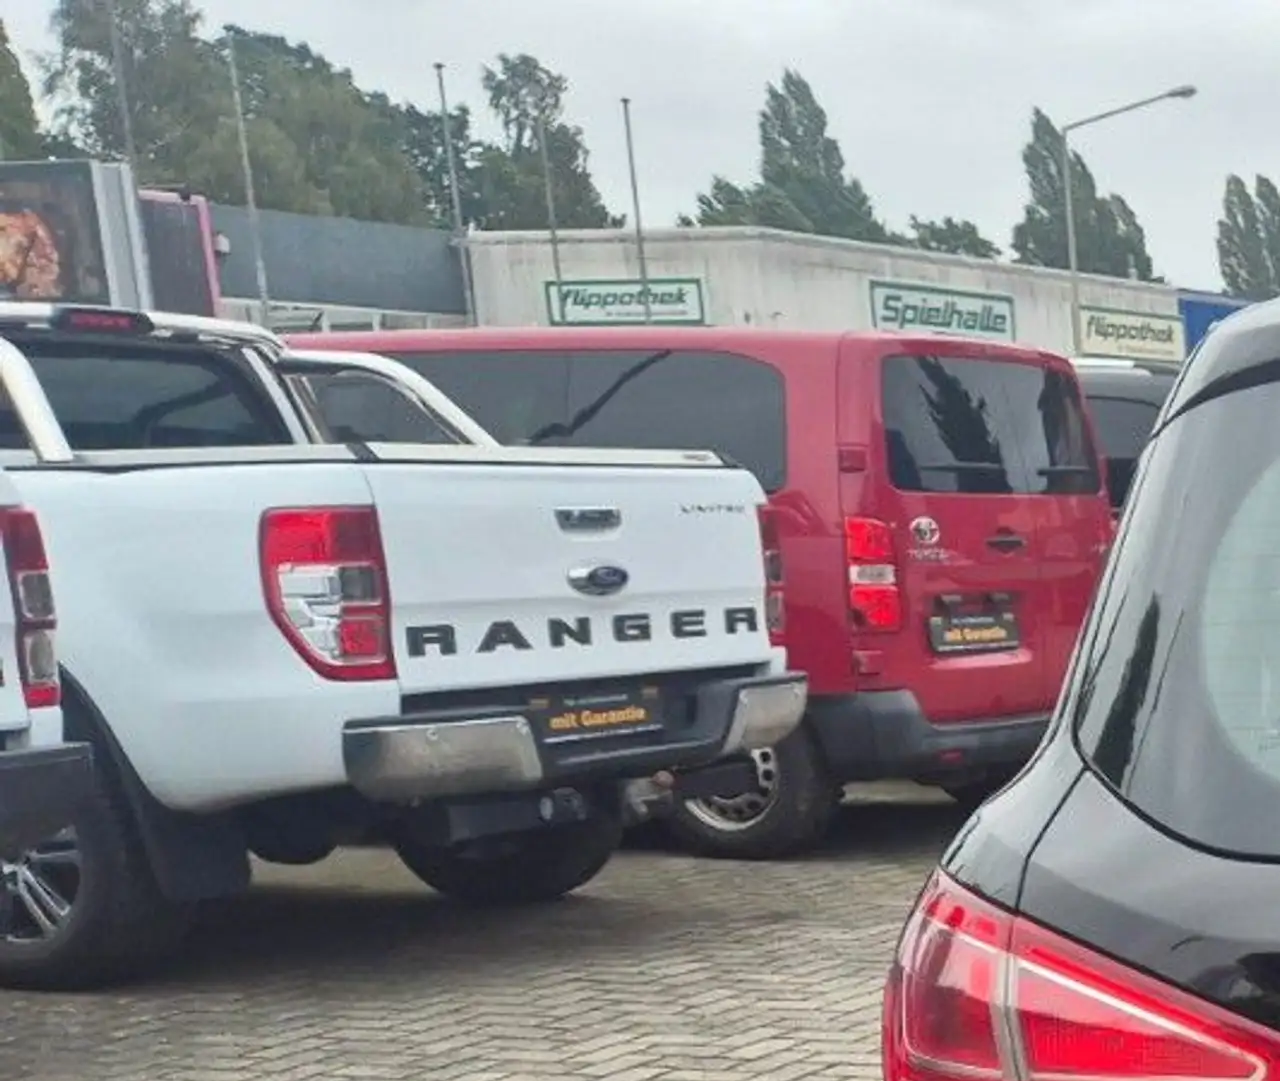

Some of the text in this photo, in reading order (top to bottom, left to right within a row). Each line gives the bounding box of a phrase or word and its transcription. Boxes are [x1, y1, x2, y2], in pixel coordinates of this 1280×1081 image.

[880, 294, 1007, 333] Spielhalle
[1085, 315, 1175, 344] flippothek
[405, 606, 758, 658] RANGER
